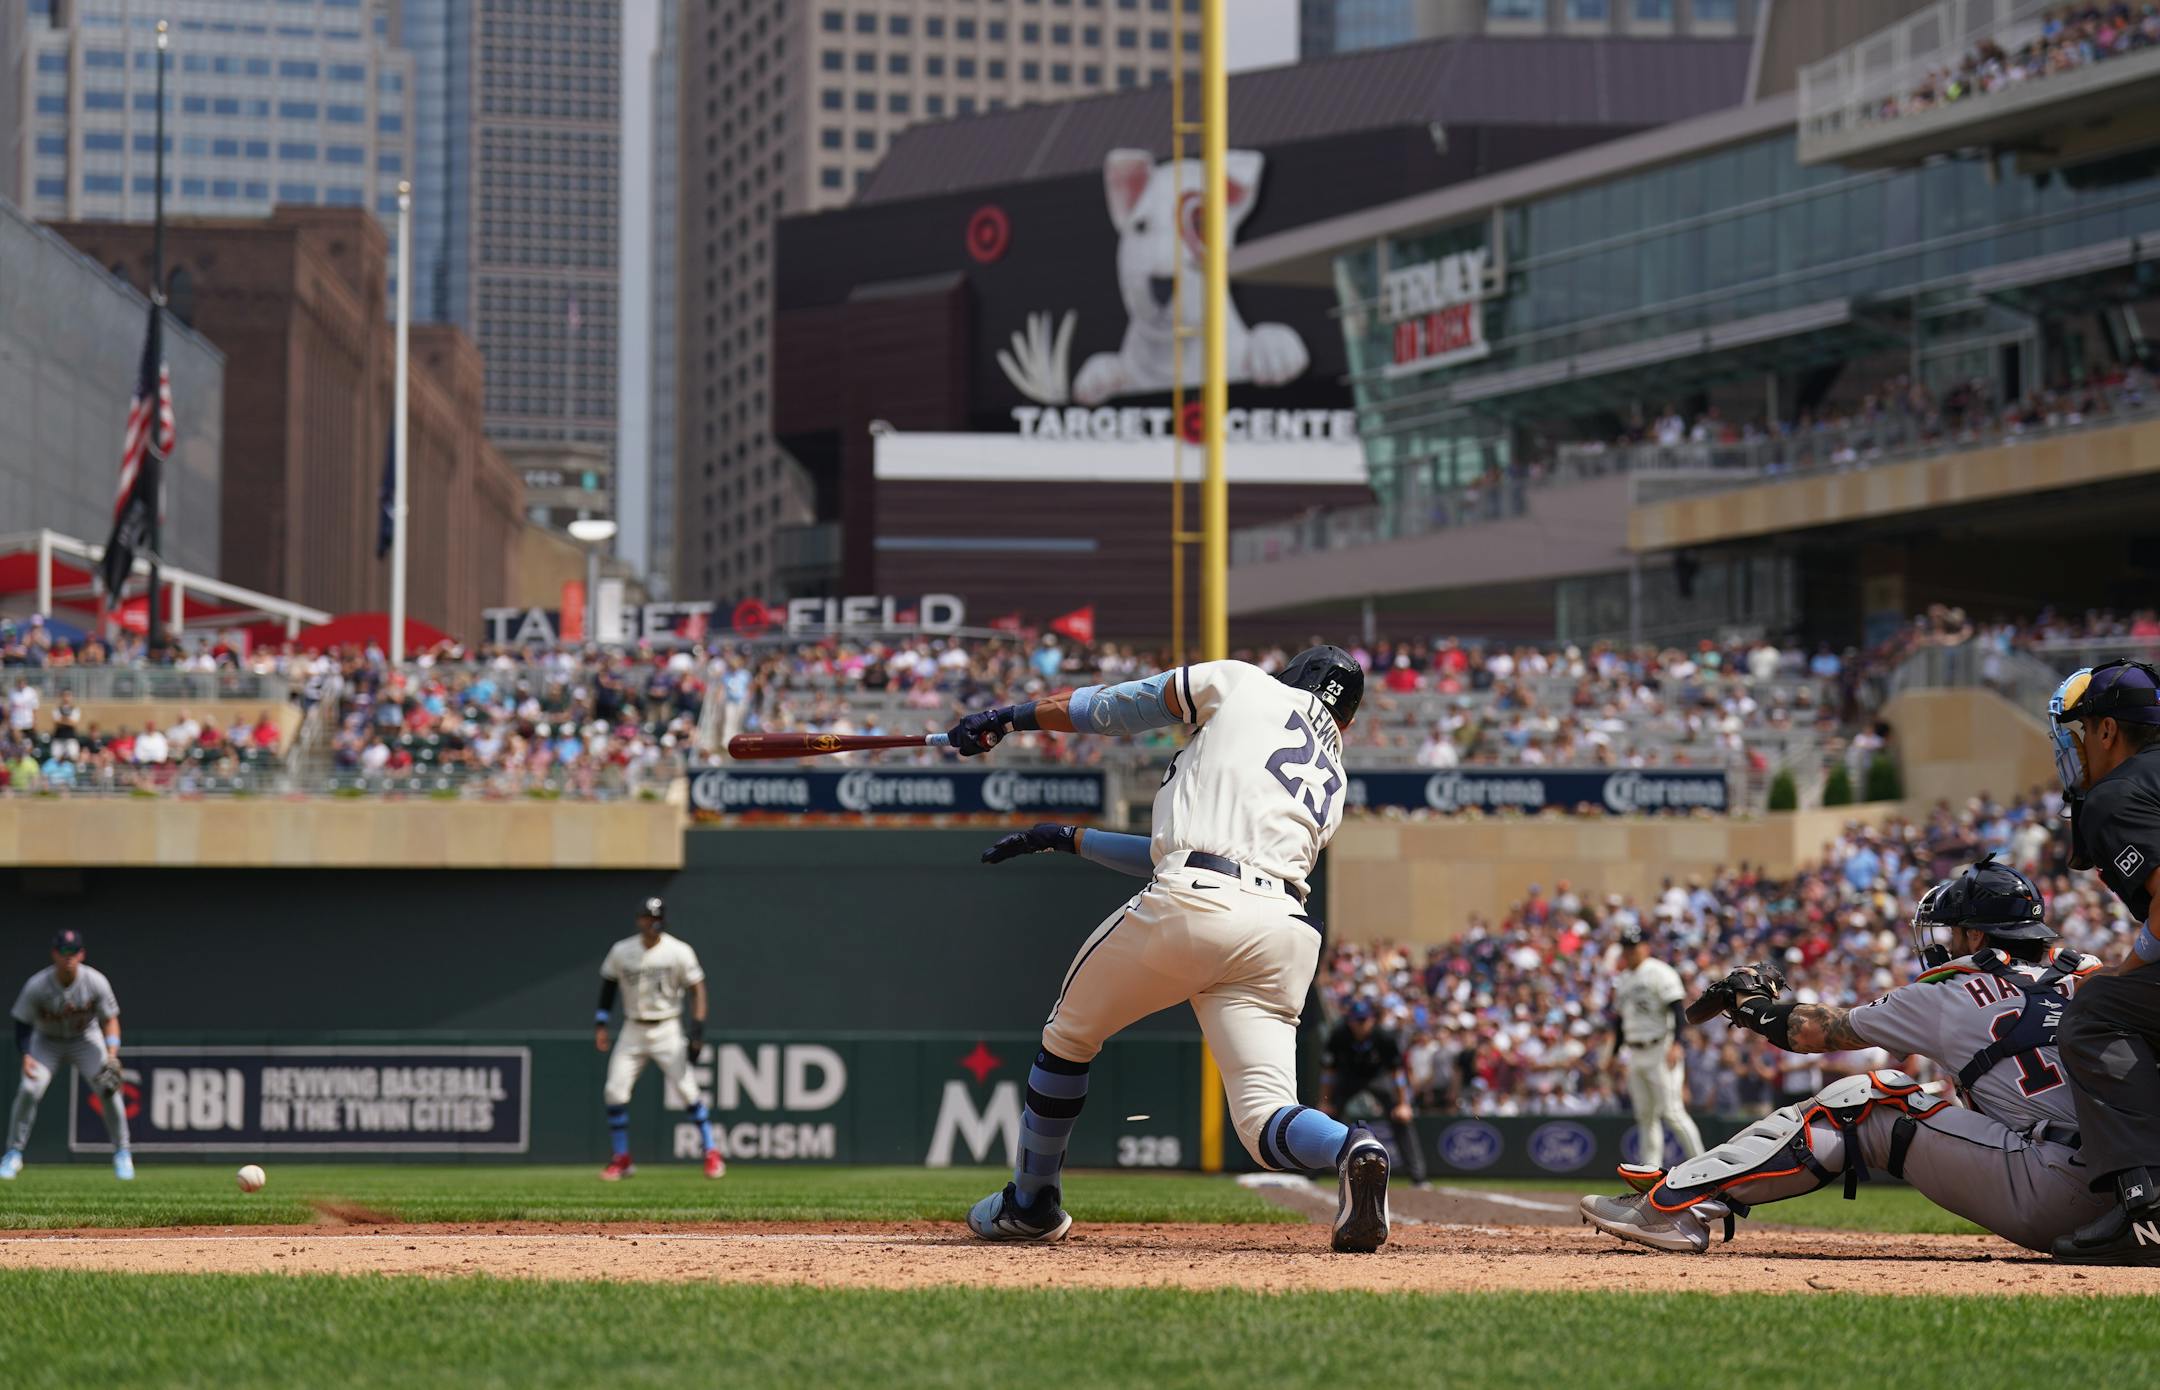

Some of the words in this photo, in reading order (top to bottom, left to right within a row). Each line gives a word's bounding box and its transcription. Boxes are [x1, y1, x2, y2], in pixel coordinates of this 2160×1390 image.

[1011, 407, 1172, 439] TARGET
[1227, 407, 1357, 441] CENTE
[481, 601, 715, 648] TAGET
[788, 594, 964, 637] FIELD
[1326, 680, 1344, 696] 23
[1307, 695, 1339, 763] LEWIS
[1265, 710, 1343, 828] 23
[691, 769, 808, 810] Corona
[836, 769, 955, 810] Corona
[981, 769, 1098, 810] Corona
[1425, 771, 1544, 811] Corona
[1603, 771, 1724, 811] Corona
[2119, 851, 2139, 871] DD
[151, 1067, 244, 1131] RBI
[260, 1067, 378, 1098] REVIVING
[381, 1067, 506, 1099] BASEBALL
[260, 1100, 290, 1131] IN
[293, 1100, 341, 1131] THE
[345, 1100, 410, 1131] TWIN
[412, 1100, 495, 1132] CITIES
[1116, 1136, 1181, 1168] 328
